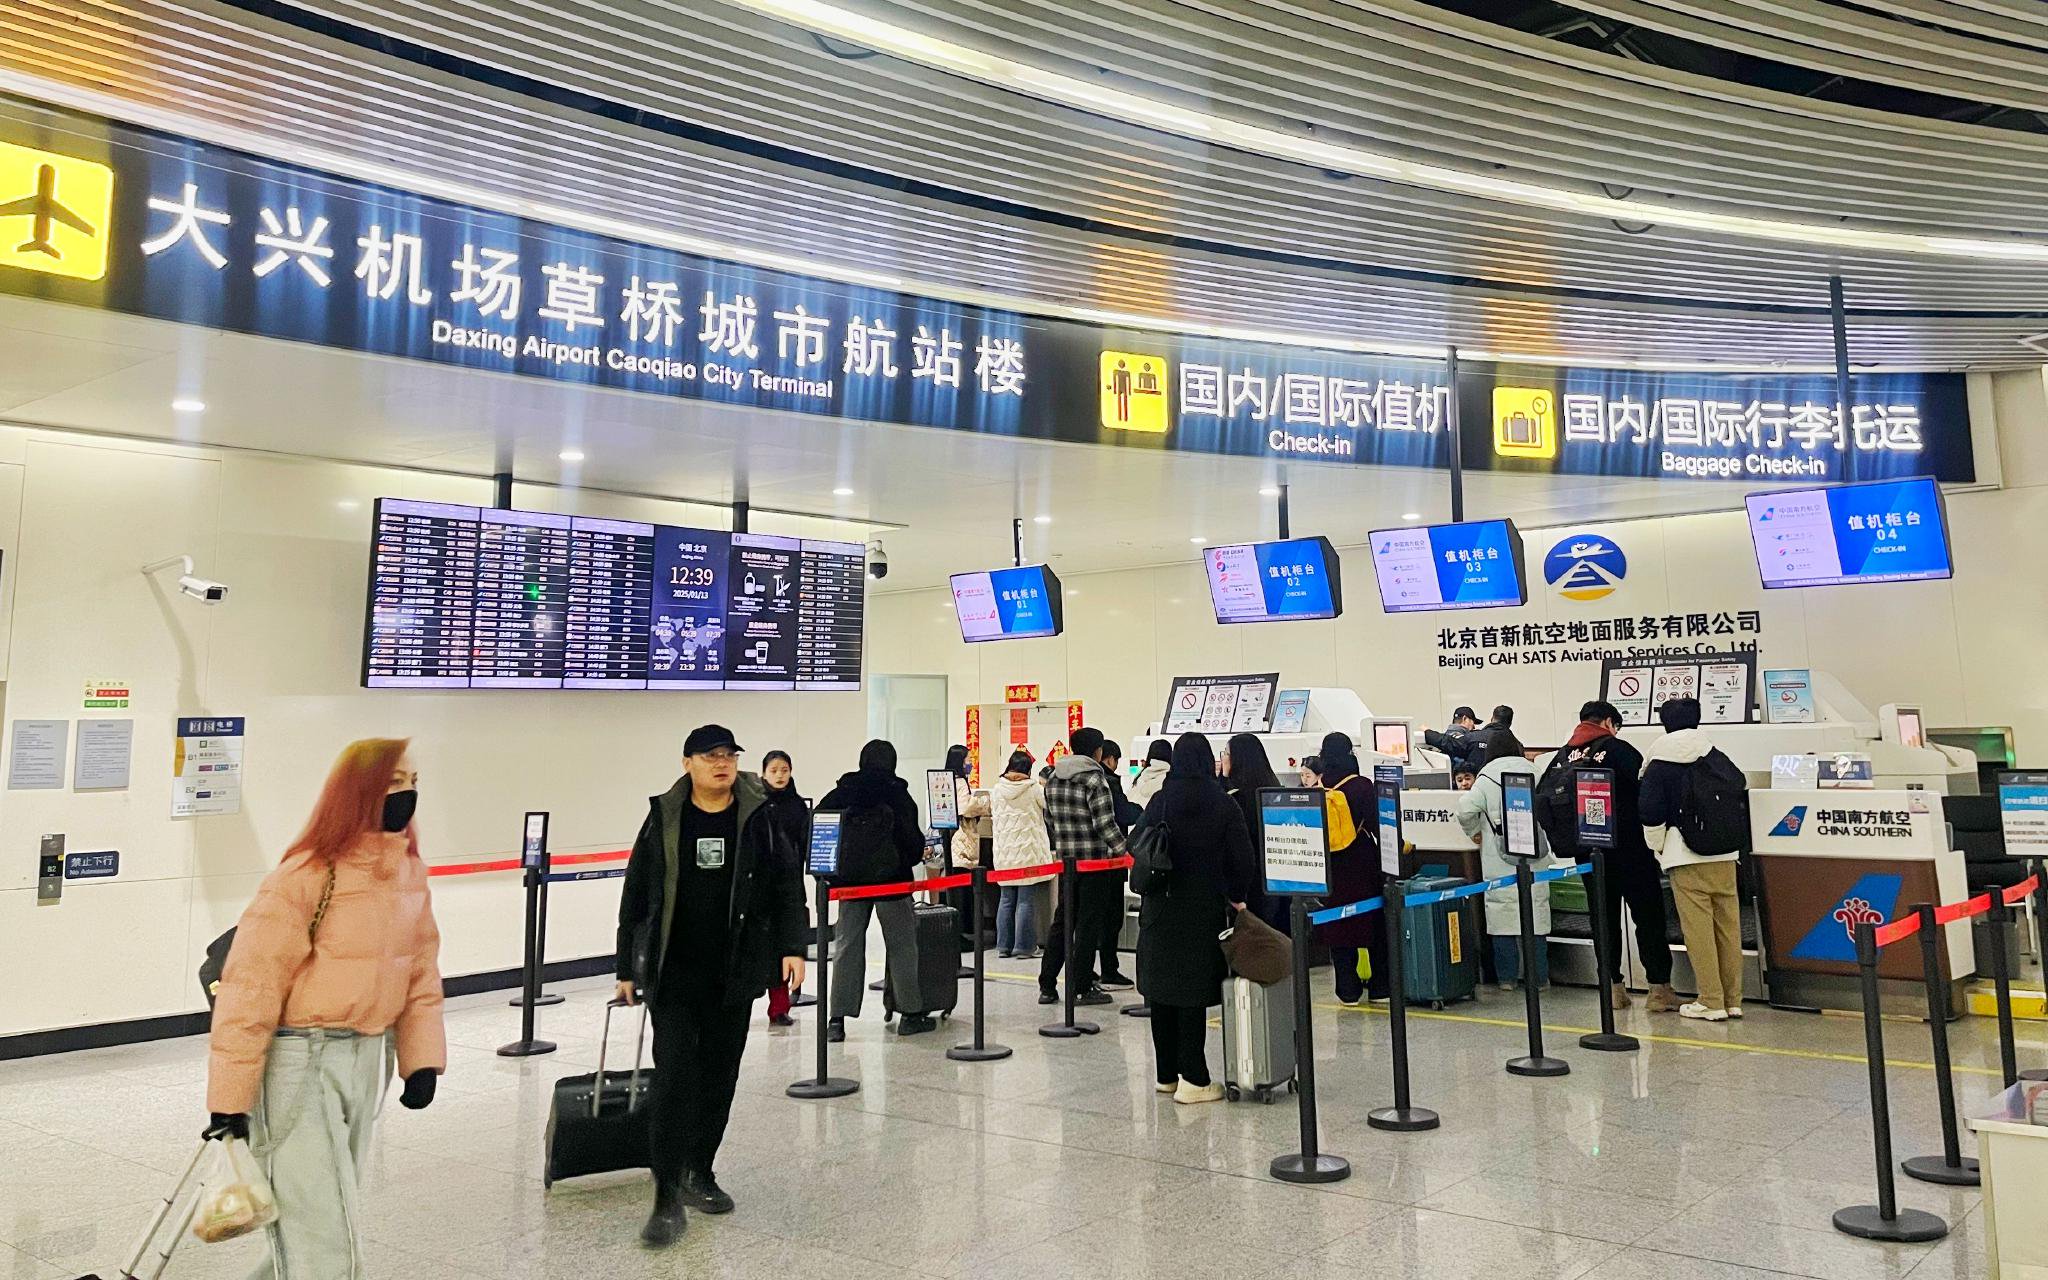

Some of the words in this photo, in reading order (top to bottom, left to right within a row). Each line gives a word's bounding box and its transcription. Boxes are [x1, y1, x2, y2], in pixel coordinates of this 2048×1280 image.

[140, 182, 1027, 398] 大兴机场草桥城市航站楼
[432, 320, 517, 360] Daxing
[523, 335, 601, 370] Airport
[606, 348, 698, 382] Caoqiao
[703, 361, 744, 393] City
[749, 367, 834, 399] Terminal
[1178, 361, 1452, 434] 国内/国际值机
[1562, 393, 1924, 452] 国内/国际行李托运
[1268, 430, 1352, 457] Check-in
[1661, 452, 1741, 477] Baggage
[1746, 453, 1826, 477] Check-in
[1847, 510, 1921, 531] 值机柜台
[1876, 528, 1898, 541] 04
[1444, 546, 1499, 563] 值机柜台
[1268, 563, 1315, 578] 值机柜台
[1466, 562, 1482, 572] 03
[670, 566, 714, 586] 12:39
[1287, 577, 1301, 587] 02
[672, 589, 709, 600] 2025/01/13
[1002, 588, 1038, 601] 值机柜台
[1017, 600, 1028, 609] 01
[1437, 610, 1762, 650] 北京首新航空地面服务有限公司
[1438, 654, 1484, 670] Beijing
[1488, 652, 1518, 665] CAH
[1522, 649, 1557, 664] SATS
[1560, 647, 1623, 662] Aviation
[1627, 644, 1693, 659] Services
[1816, 809, 1912, 826] 中国南方航空
[1817, 825, 1851, 836] CHINA
[1853, 826, 1913, 838] SOUTHERN
[71, 855, 114, 868] 禁止下行
